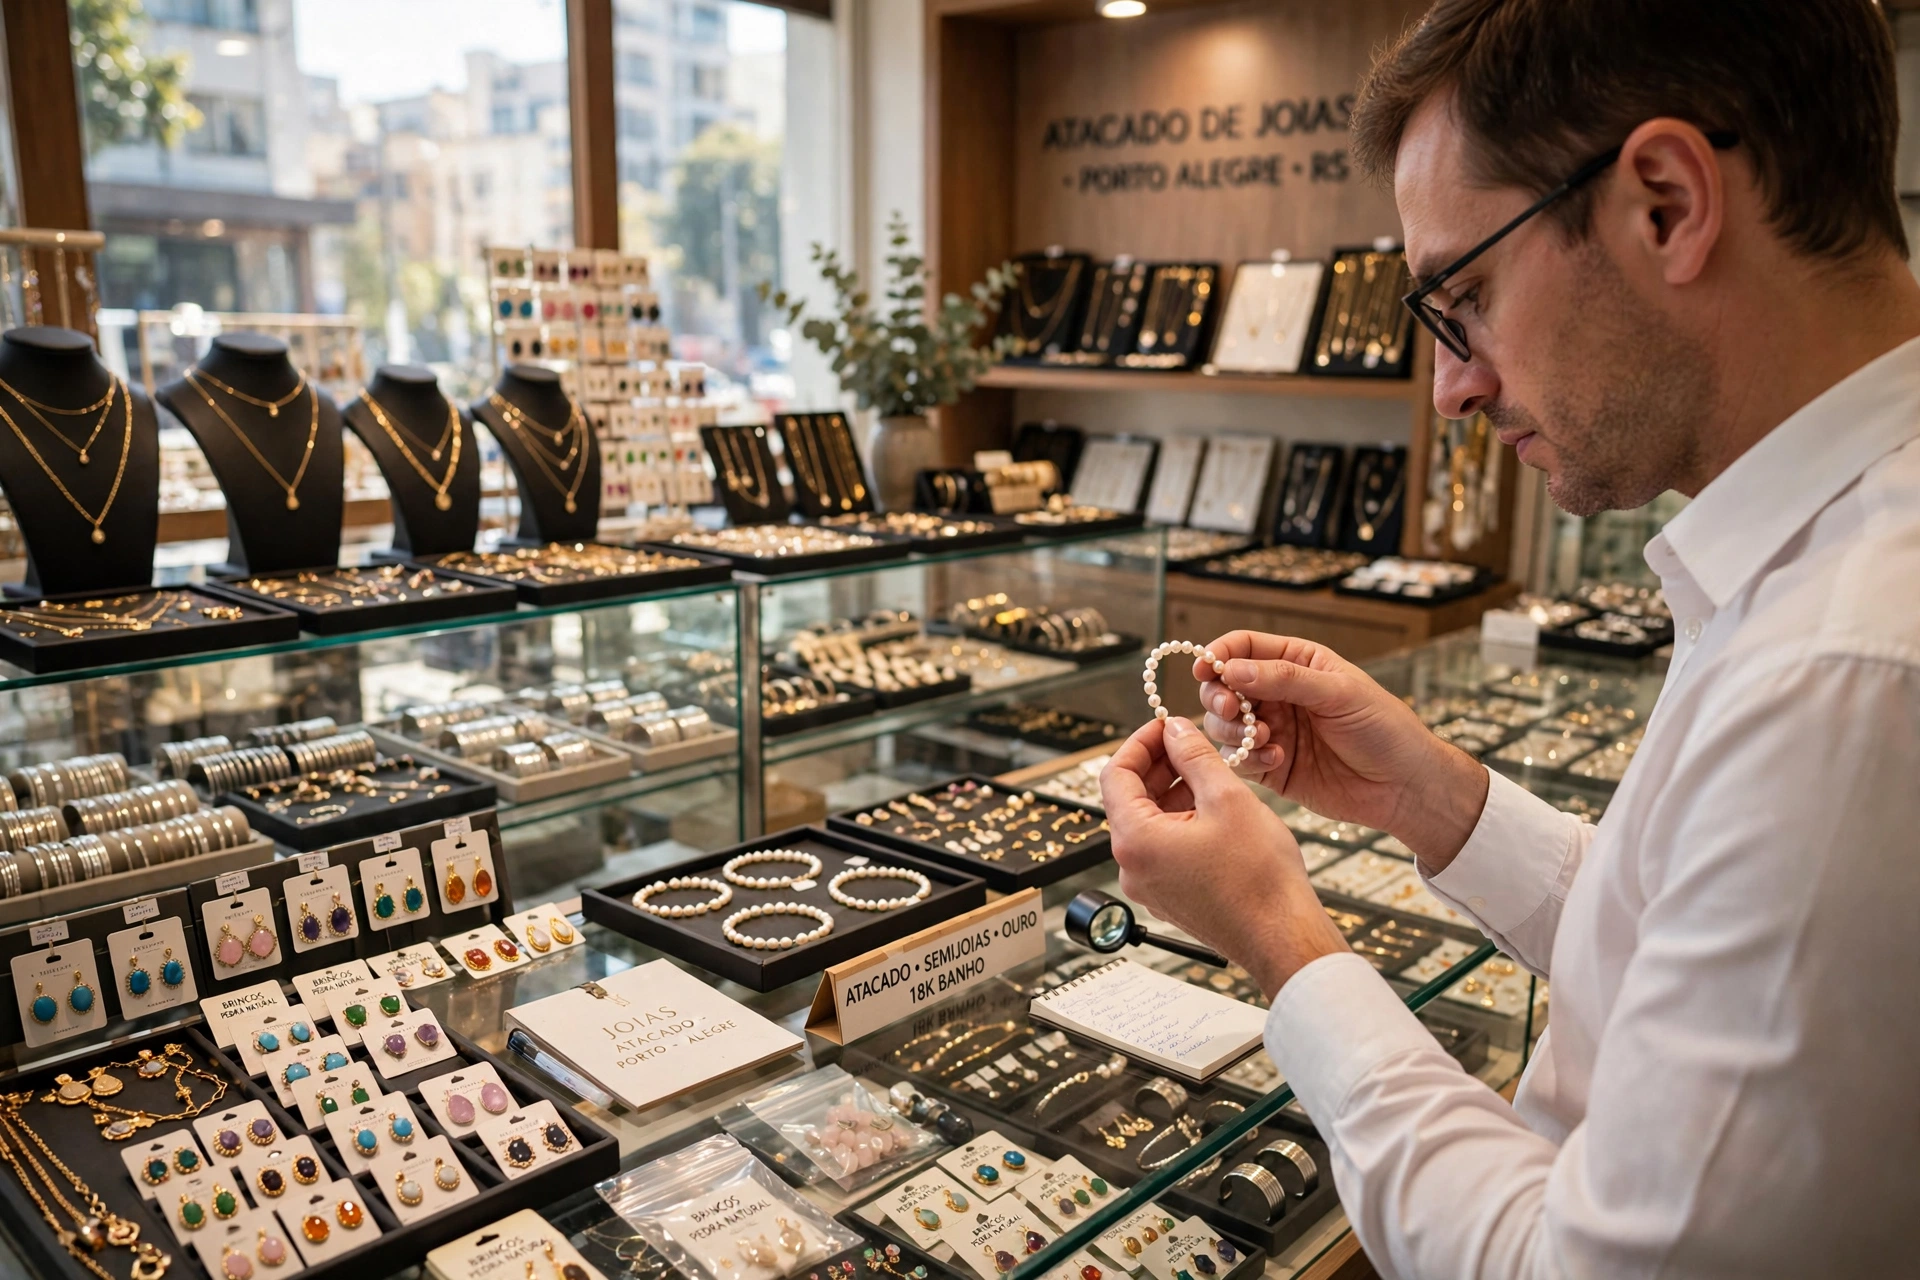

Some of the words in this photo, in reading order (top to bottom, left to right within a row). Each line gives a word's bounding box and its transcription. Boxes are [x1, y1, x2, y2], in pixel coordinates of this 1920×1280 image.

[1043, 108, 1191, 148] ATACADO
[1200, 104, 1243, 141] DE
[1257, 94, 1354, 137] JOIAS
[1079, 161, 1168, 194] PORTO
[1175, 153, 1282, 189] ALEGRE
[1310, 151, 1350, 182] RS
[845, 963, 911, 1007] ATACADO
[924, 929, 991, 972] SEMIJOIAS
[1002, 910, 1037, 938] OURO
[222, 992, 265, 1009] BRINCOS
[909, 978, 935, 1004] 18K
[938, 957, 985, 991] BANHO
[602, 1006, 677, 1040] JOIAS
[616, 1019, 695, 1053] ATACADO
[616, 1045, 667, 1069] PORTO
[687, 1020, 737, 1044] ALEGRE
[689, 1221, 727, 1242] PEDRA
